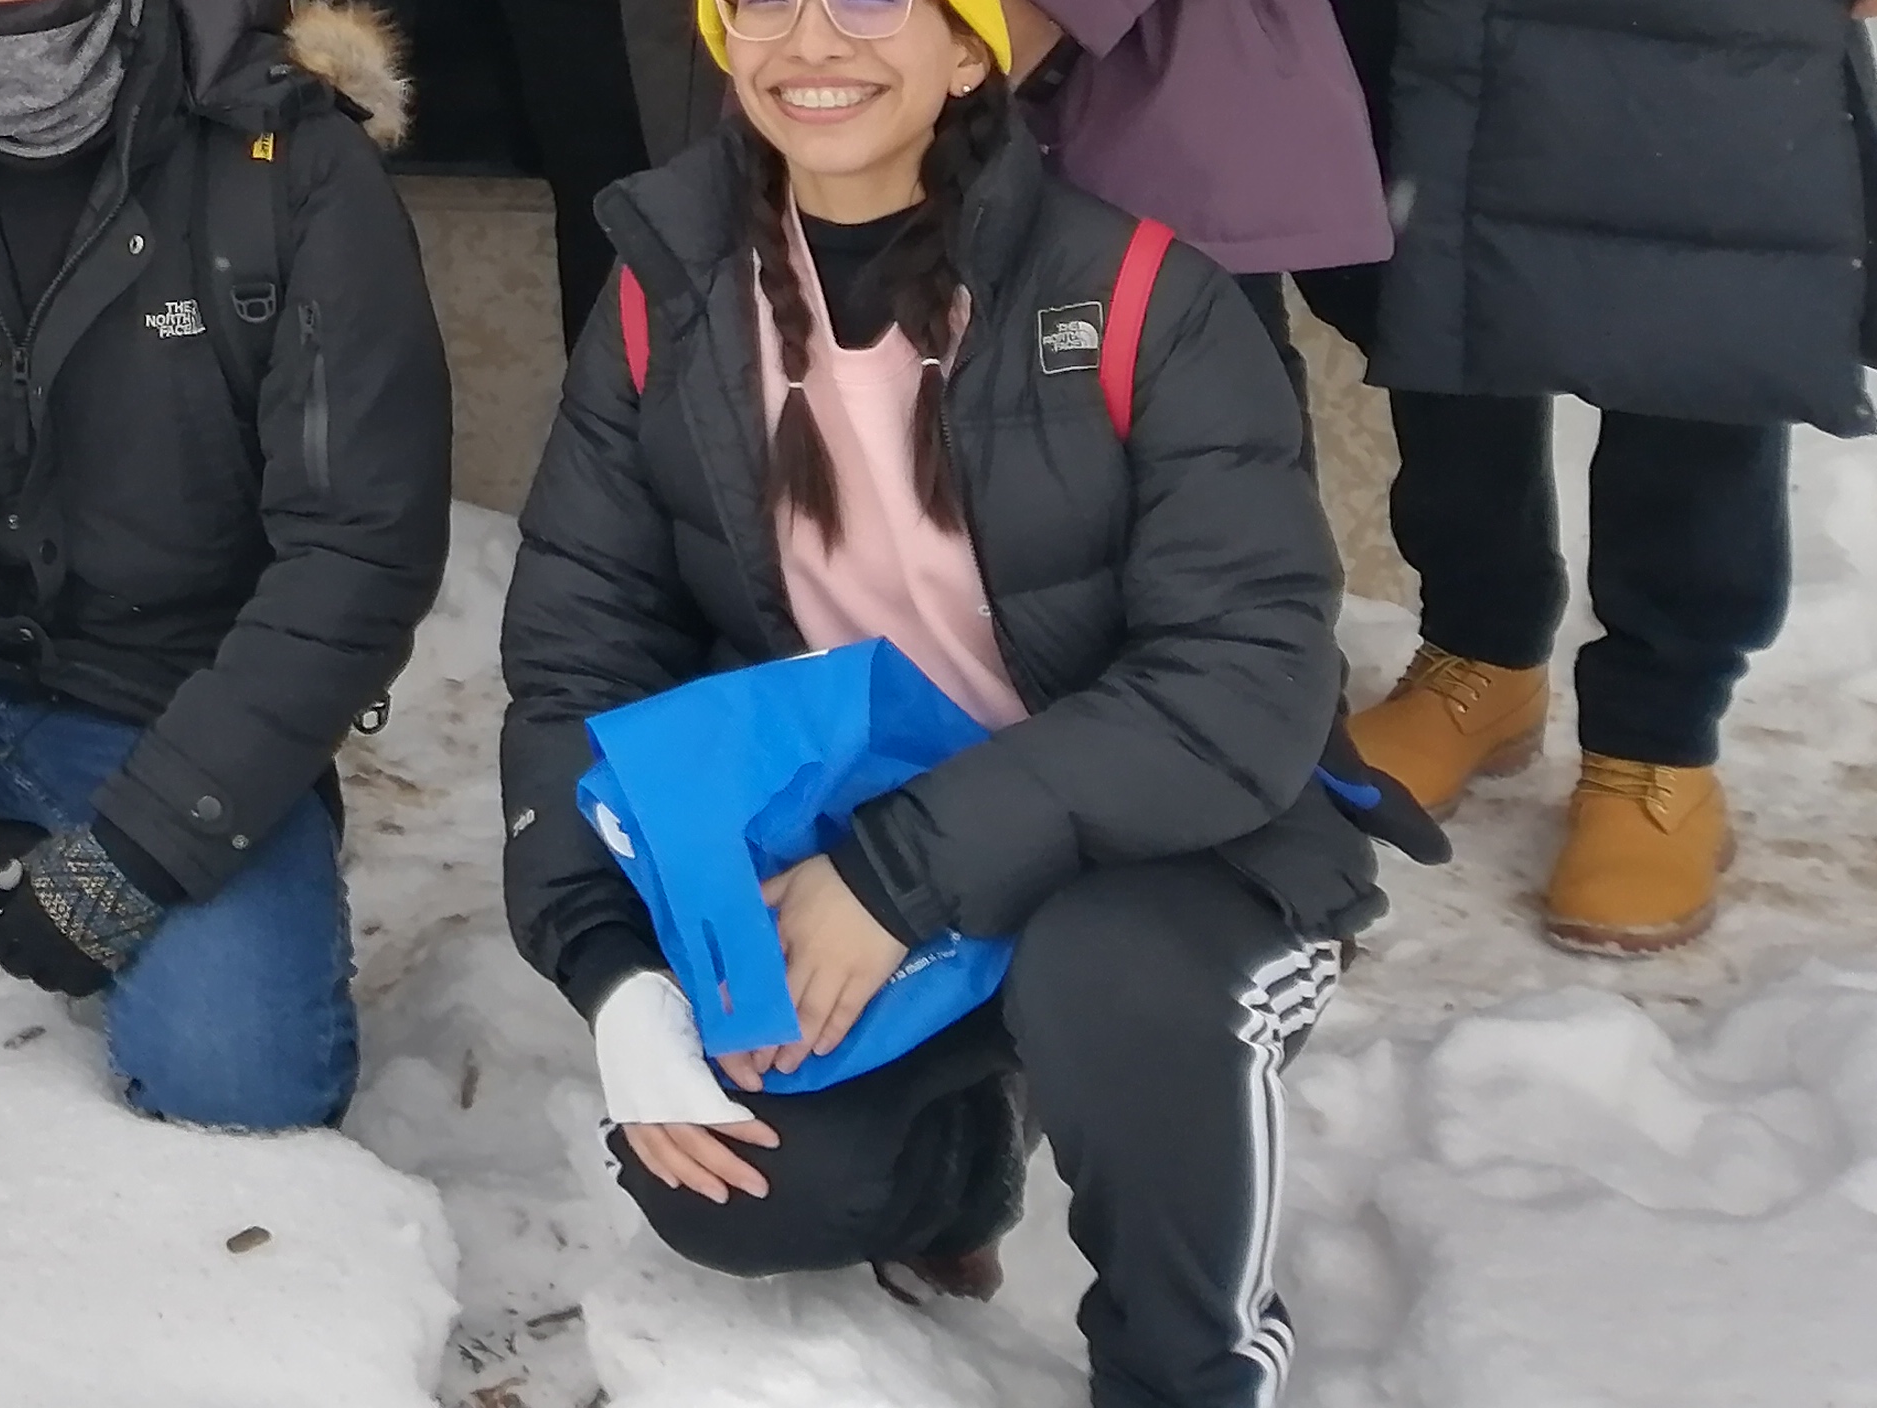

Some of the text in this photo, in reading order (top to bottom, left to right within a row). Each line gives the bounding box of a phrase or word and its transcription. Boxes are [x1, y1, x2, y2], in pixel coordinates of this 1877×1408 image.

[165, 301, 193, 314] THE
[145, 313, 191, 327] NORTH
[159, 325, 192, 338] FACE
